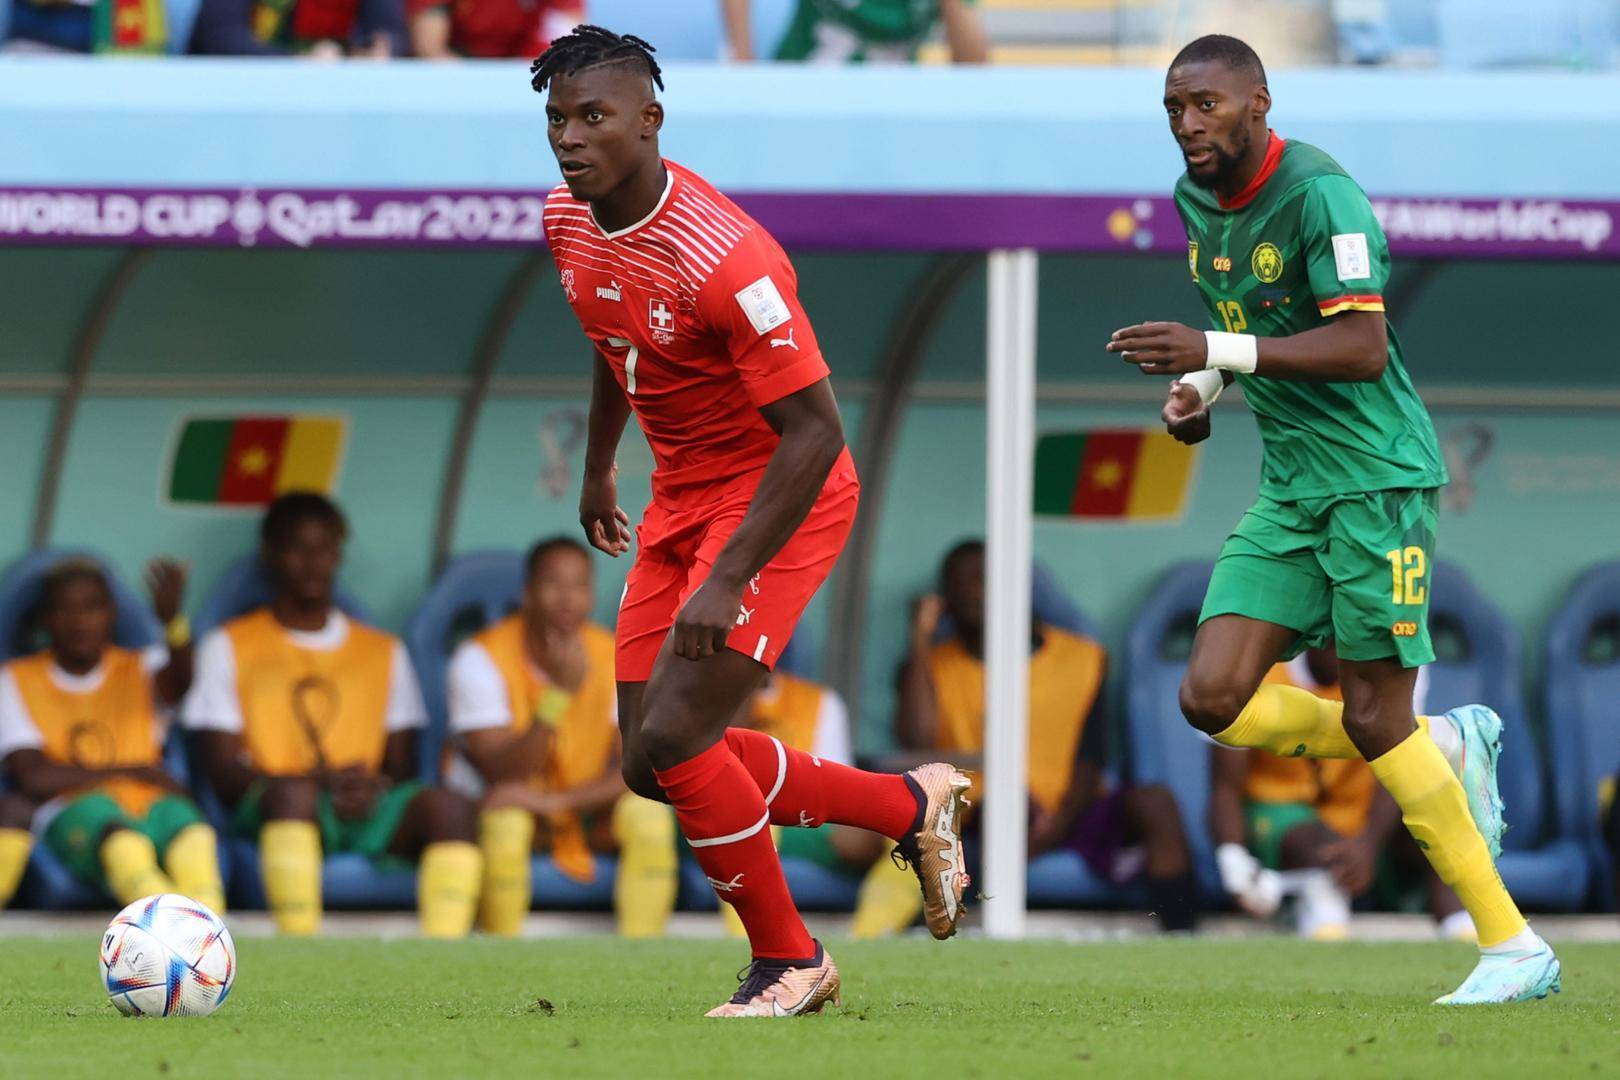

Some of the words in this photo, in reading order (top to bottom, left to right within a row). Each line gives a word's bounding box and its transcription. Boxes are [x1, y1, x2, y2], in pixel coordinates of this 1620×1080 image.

[142, 193, 230, 237] CUP
[1212, 256, 1233, 272] one
[1216, 300, 1247, 333] 12
[606, 337, 639, 395] 7
[1386, 546, 1426, 605] 12
[1392, 621, 1418, 637] one
